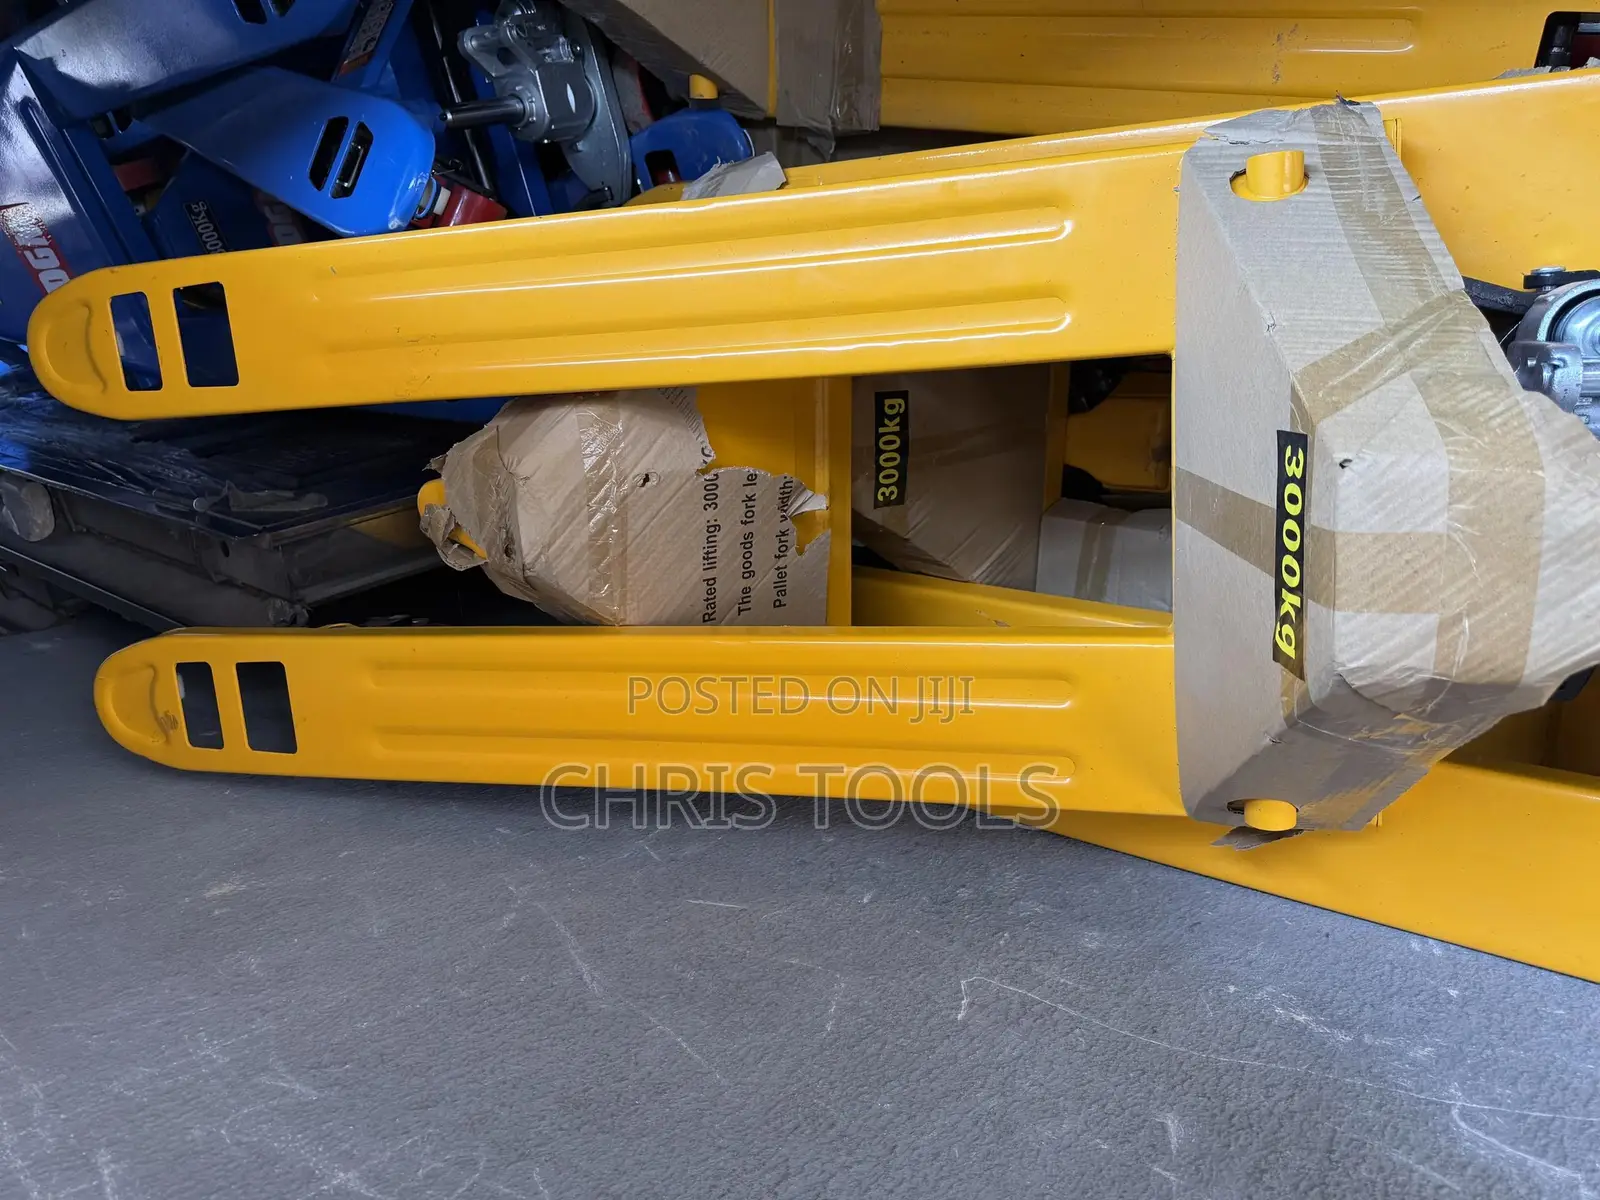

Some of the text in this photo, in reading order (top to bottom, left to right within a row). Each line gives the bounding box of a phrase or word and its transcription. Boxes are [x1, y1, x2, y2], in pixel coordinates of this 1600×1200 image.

[878, 398, 905, 501] 3000kg
[702, 518, 721, 571] lifting:
[738, 470, 758, 616] The goods fork le
[775, 528, 789, 561] fork
[1275, 444, 1304, 659] 3000kg
[702, 577, 717, 623] Rated
[773, 564, 787, 608] Pallet
